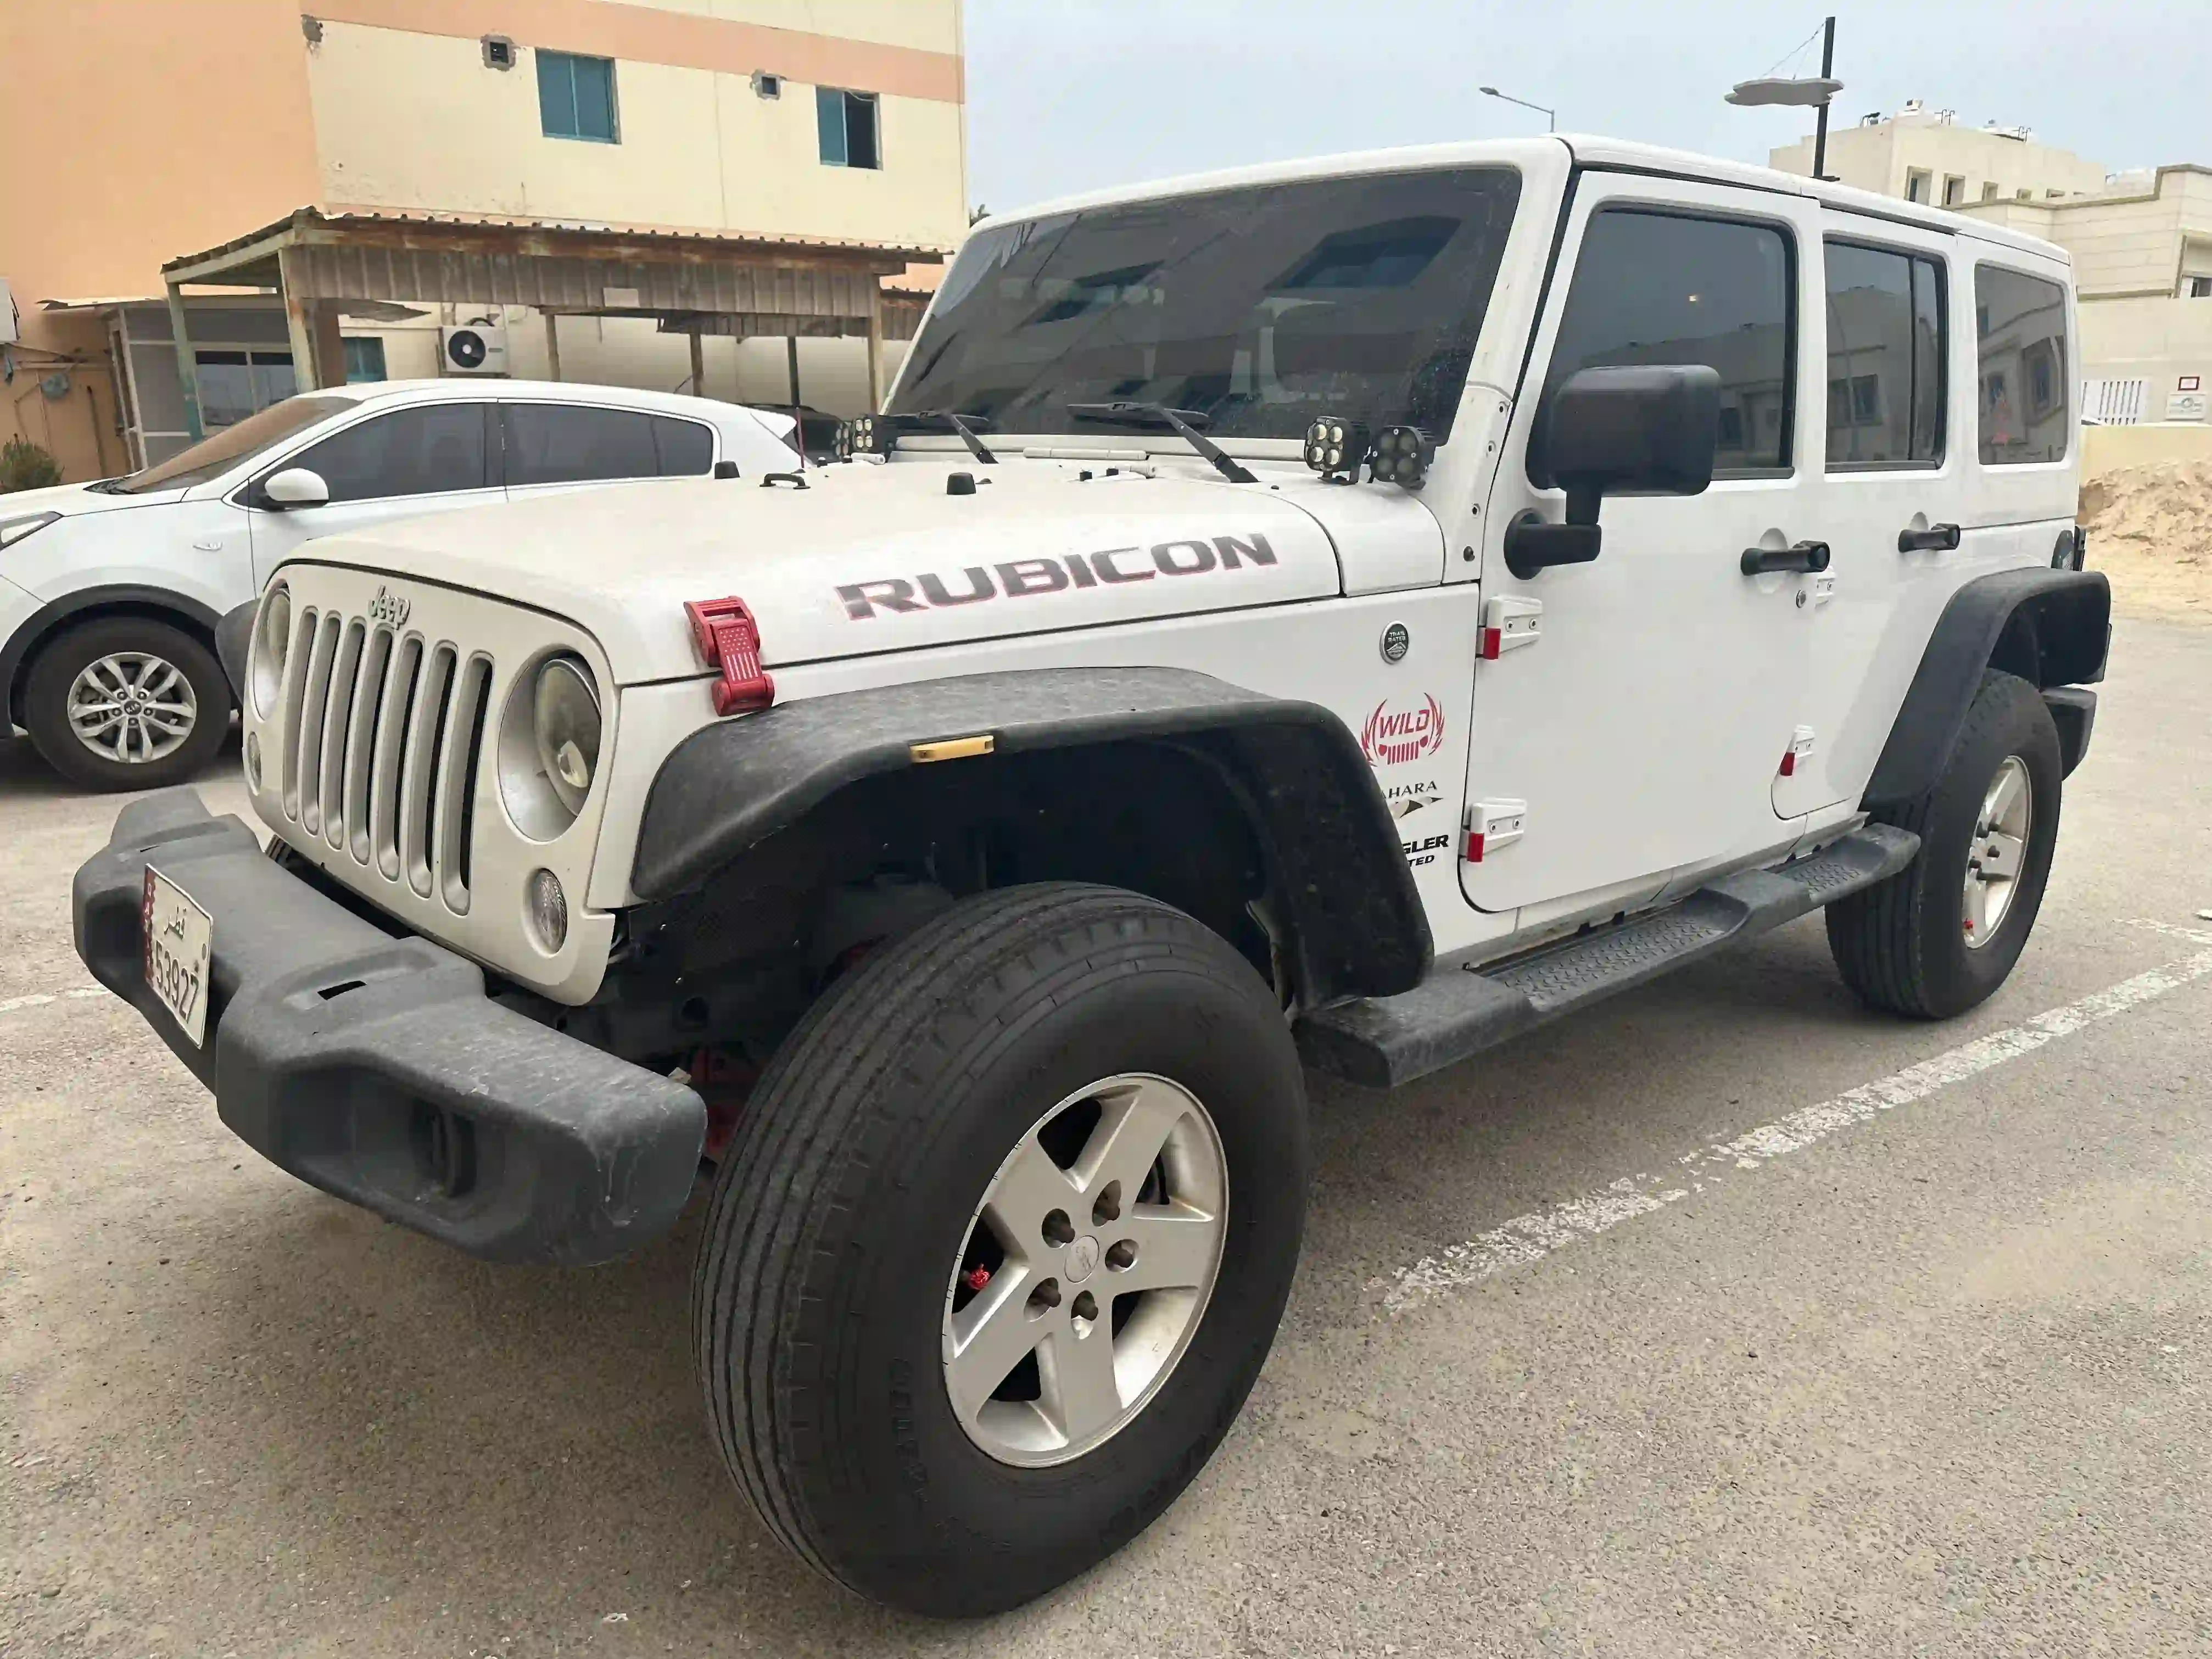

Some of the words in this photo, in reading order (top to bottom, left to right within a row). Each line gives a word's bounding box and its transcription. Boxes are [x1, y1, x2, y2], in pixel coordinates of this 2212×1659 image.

[833, 533, 1278, 621] RUBICON
[367, 584, 411, 630] Jeep
[1379, 709, 1429, 739] WILD
[164, 904, 187, 940] قطر
[156, 939, 199, 1024] 53927
